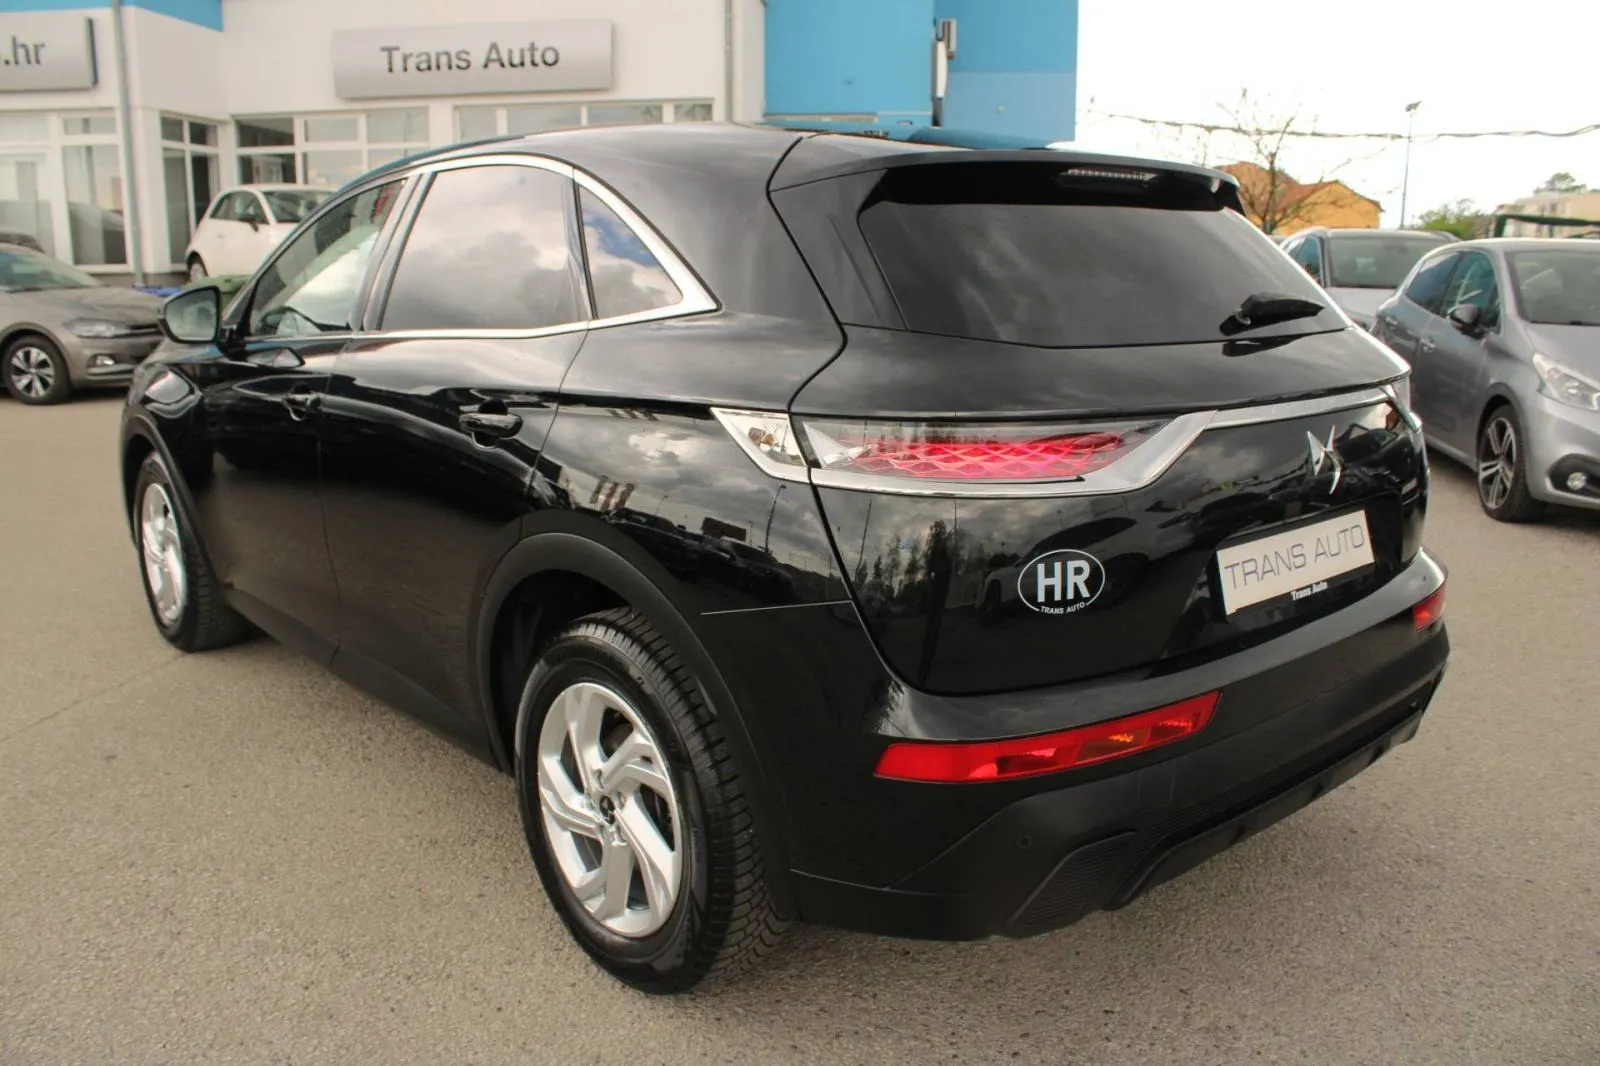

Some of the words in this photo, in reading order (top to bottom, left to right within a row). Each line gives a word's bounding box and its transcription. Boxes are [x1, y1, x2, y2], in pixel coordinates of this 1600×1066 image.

[380, 45, 472, 73] Trans
[482, 41, 560, 69] Auto
[1224, 543, 1307, 589] TRANS
[1314, 524, 1365, 563] AUTO
[1037, 559, 1091, 602] HR
[1291, 587, 1312, 601] Trans
[1312, 580, 1328, 595] Auto
[1040, 605, 1065, 615] TRANS
[1066, 601, 1086, 613] AUTO
